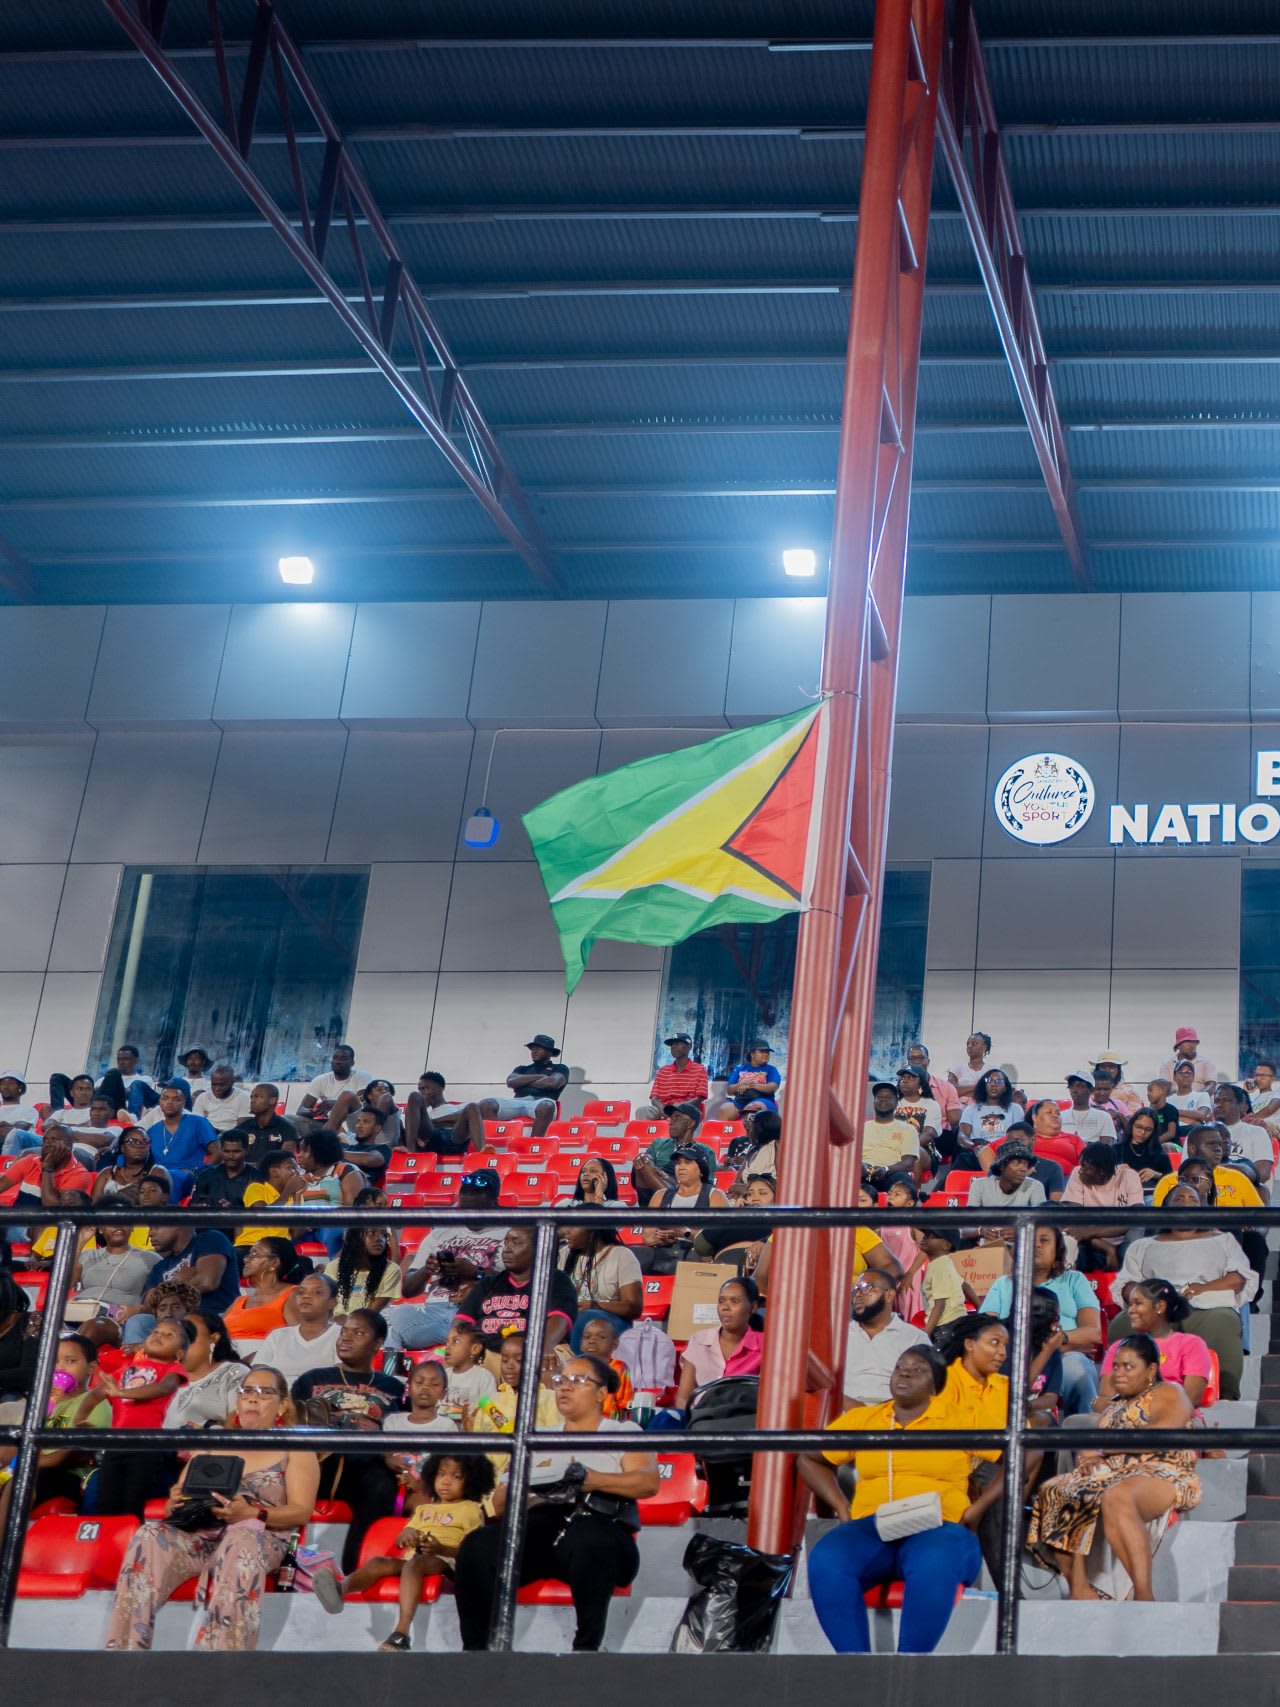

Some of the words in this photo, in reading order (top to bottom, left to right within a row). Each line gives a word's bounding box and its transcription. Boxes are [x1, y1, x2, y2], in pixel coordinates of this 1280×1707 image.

[647, 1282, 661, 1293] 22
[482, 1294, 530, 1315] CHICAG
[79, 1522, 101, 1540] 21
